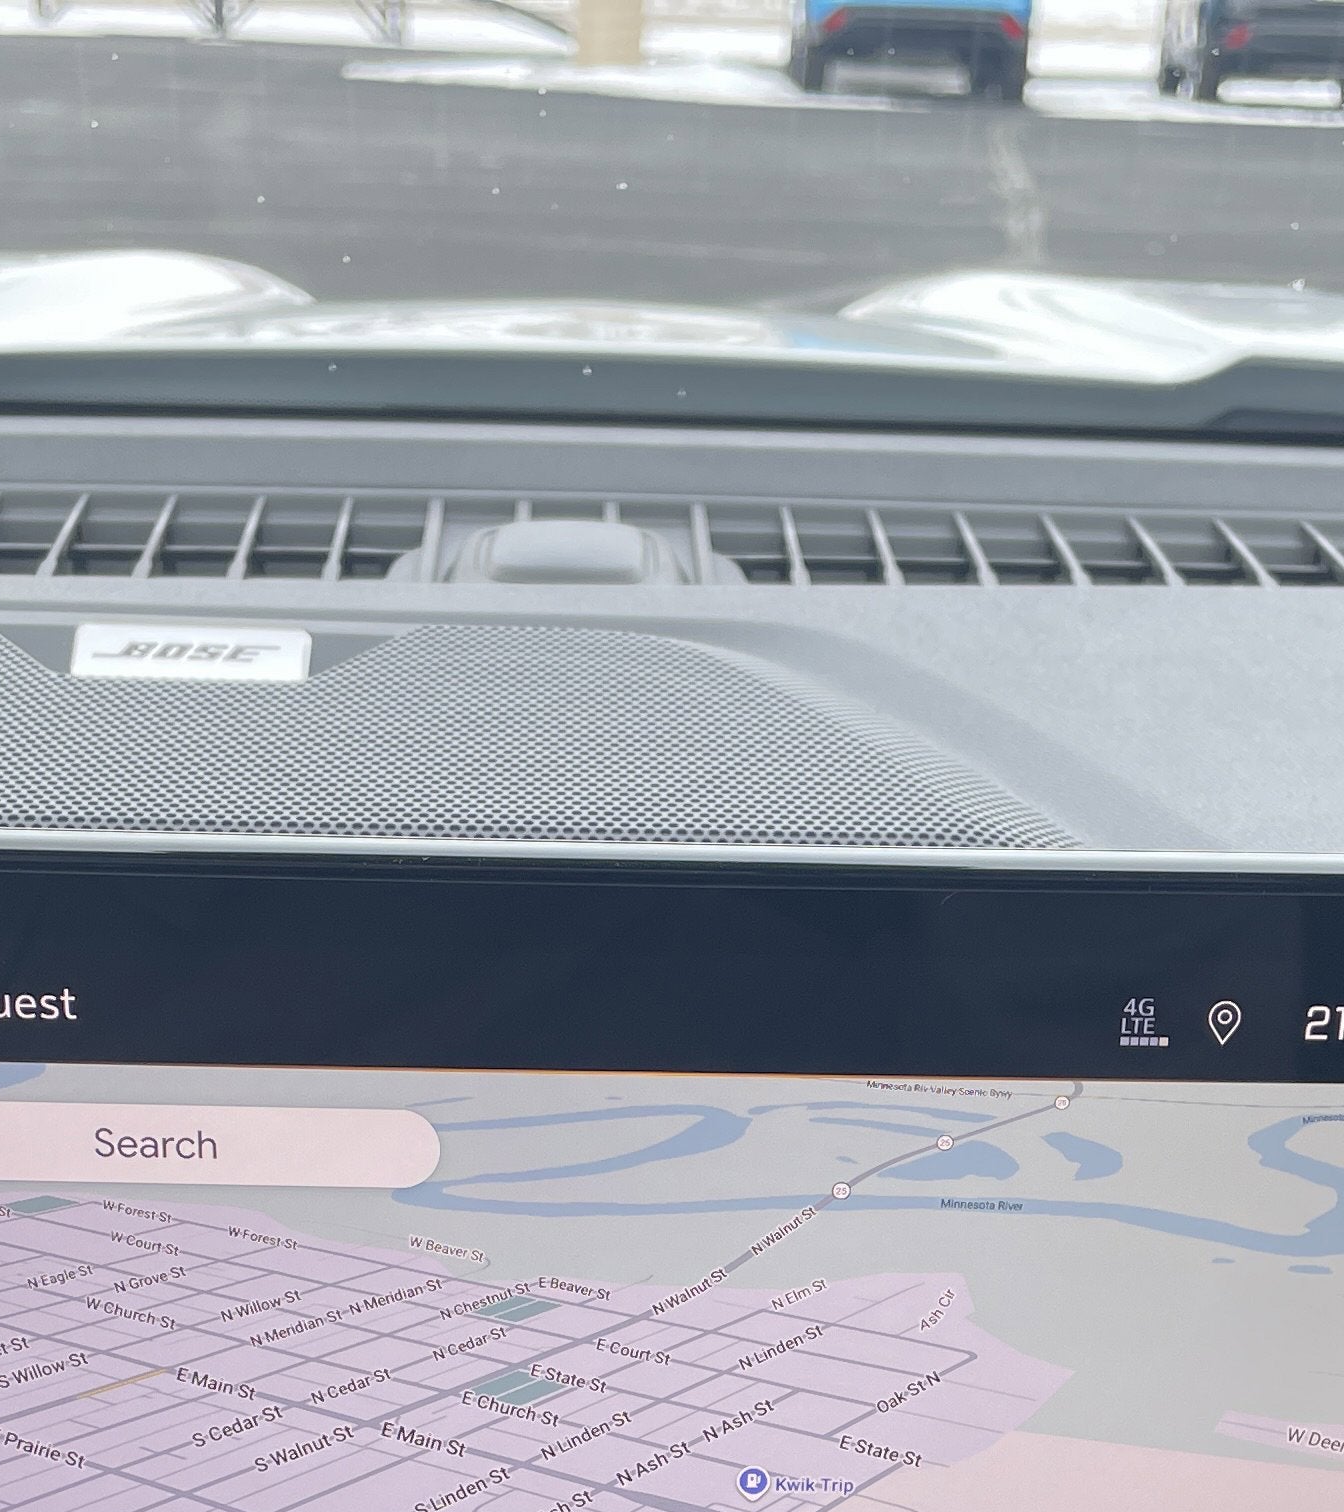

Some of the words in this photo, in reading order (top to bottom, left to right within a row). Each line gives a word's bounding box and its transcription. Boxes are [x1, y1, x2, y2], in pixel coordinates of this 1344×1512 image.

[92, 640, 282, 663] BOSE
[1123, 998, 1154, 1017] 4G
[1121, 1018, 1155, 1034] LTE
[93, 1127, 218, 1160] Search
[103, 1200, 115, 1211] W
[117, 1203, 156, 1220] Forest
[158, 1212, 172, 1223] St
[940, 1199, 995, 1211] Minnesota
[998, 1201, 1023, 1211] River
[111, 1231, 123, 1242] W
[126, 1235, 161, 1251] Court
[164, 1244, 179, 1256] St
[410, 1236, 422, 1247] W
[425, 1239, 468, 1258] Beaver
[471, 1250, 484, 1263] St
[27, 1278, 38, 1289] N
[42, 1270, 75, 1286] Eagle
[78, 1265, 93, 1276] St
[114, 1281, 126, 1293] N
[129, 1272, 167, 1289] Grove
[170, 1266, 186, 1279] St
[652, 1303, 666, 1316] N
[665, 1278, 711, 1310] Walnut
[711, 1269, 726, 1283] St
[220, 1310, 233, 1323] N
[235, 1296, 281, 1318] Willow
[284, 1290, 301, 1303] St
[440, 1309, 452, 1320] N
[453, 1289, 512, 1316] Chestnut
[514, 1282, 530, 1296] St
[771, 1299, 784, 1311] N
[786, 1287, 812, 1305] Elm
[813, 1279, 827, 1293] St
[919, 1309, 941, 1331] Ash
[938, 1288, 956, 1309] Cir
[86, 1297, 100, 1310] W
[104, 1302, 155, 1325] Church
[160, 1317, 176, 1330] St
[250, 1335, 262, 1346] N
[264, 1316, 324, 1343] Meridian
[326, 1310, 343, 1323] St
[10, 1337, 30, 1352] St
[596, 1338, 606, 1351] E
[610, 1342, 652, 1361] Court
[654, 1351, 671, 1366] St
[12, 1359, 65, 1384] Willow
[68, 1352, 89, 1368] St
[531, 1364, 541, 1376] E
[544, 1367, 586, 1390] State
[589, 1378, 607, 1394] St
[176, 1368, 189, 1382] E
[191, 1371, 233, 1394] Main
[238, 1384, 256, 1401] St
[311, 1391, 324, 1404] N
[327, 1377, 371, 1399] Cedar
[373, 1368, 391, 1382] St
[876, 1391, 906, 1414] Oak
[907, 1382, 925, 1397] St
[926, 1371, 941, 1387] N
[461, 1391, 473, 1405] E
[477, 1395, 536, 1422] Church
[540, 1411, 559, 1427] St
[192, 1433, 206, 1447] S
[208, 1415, 259, 1442] Cedar
[262, 1405, 283, 1422] St
[541, 1445, 555, 1461] N
[558, 1423, 610, 1453] Linden
[612, 1411, 632, 1427] St
[1287, 1428, 1305, 1443] W
[4, 1431, 61, 1461] Prairie
[65, 1451, 85, 1469] St
[254, 1457, 269, 1472] S
[270, 1436, 331, 1467] Walnut
[333, 1426, 355, 1442] St
[616, 1472, 632, 1486] N
[635, 1453, 669, 1477] Ash
[670, 1442, 691, 1459] St
[839, 1436, 851, 1449] E
[855, 1439, 899, 1462] State
[902, 1451, 922, 1467] St
[429, 1479, 488, 1511] Linden
[489, 1467, 510, 1484] St
[572, 1490, 593, 1507] St
[776, 1478, 815, 1492] Kwik
[822, 1478, 854, 1495] Trip
